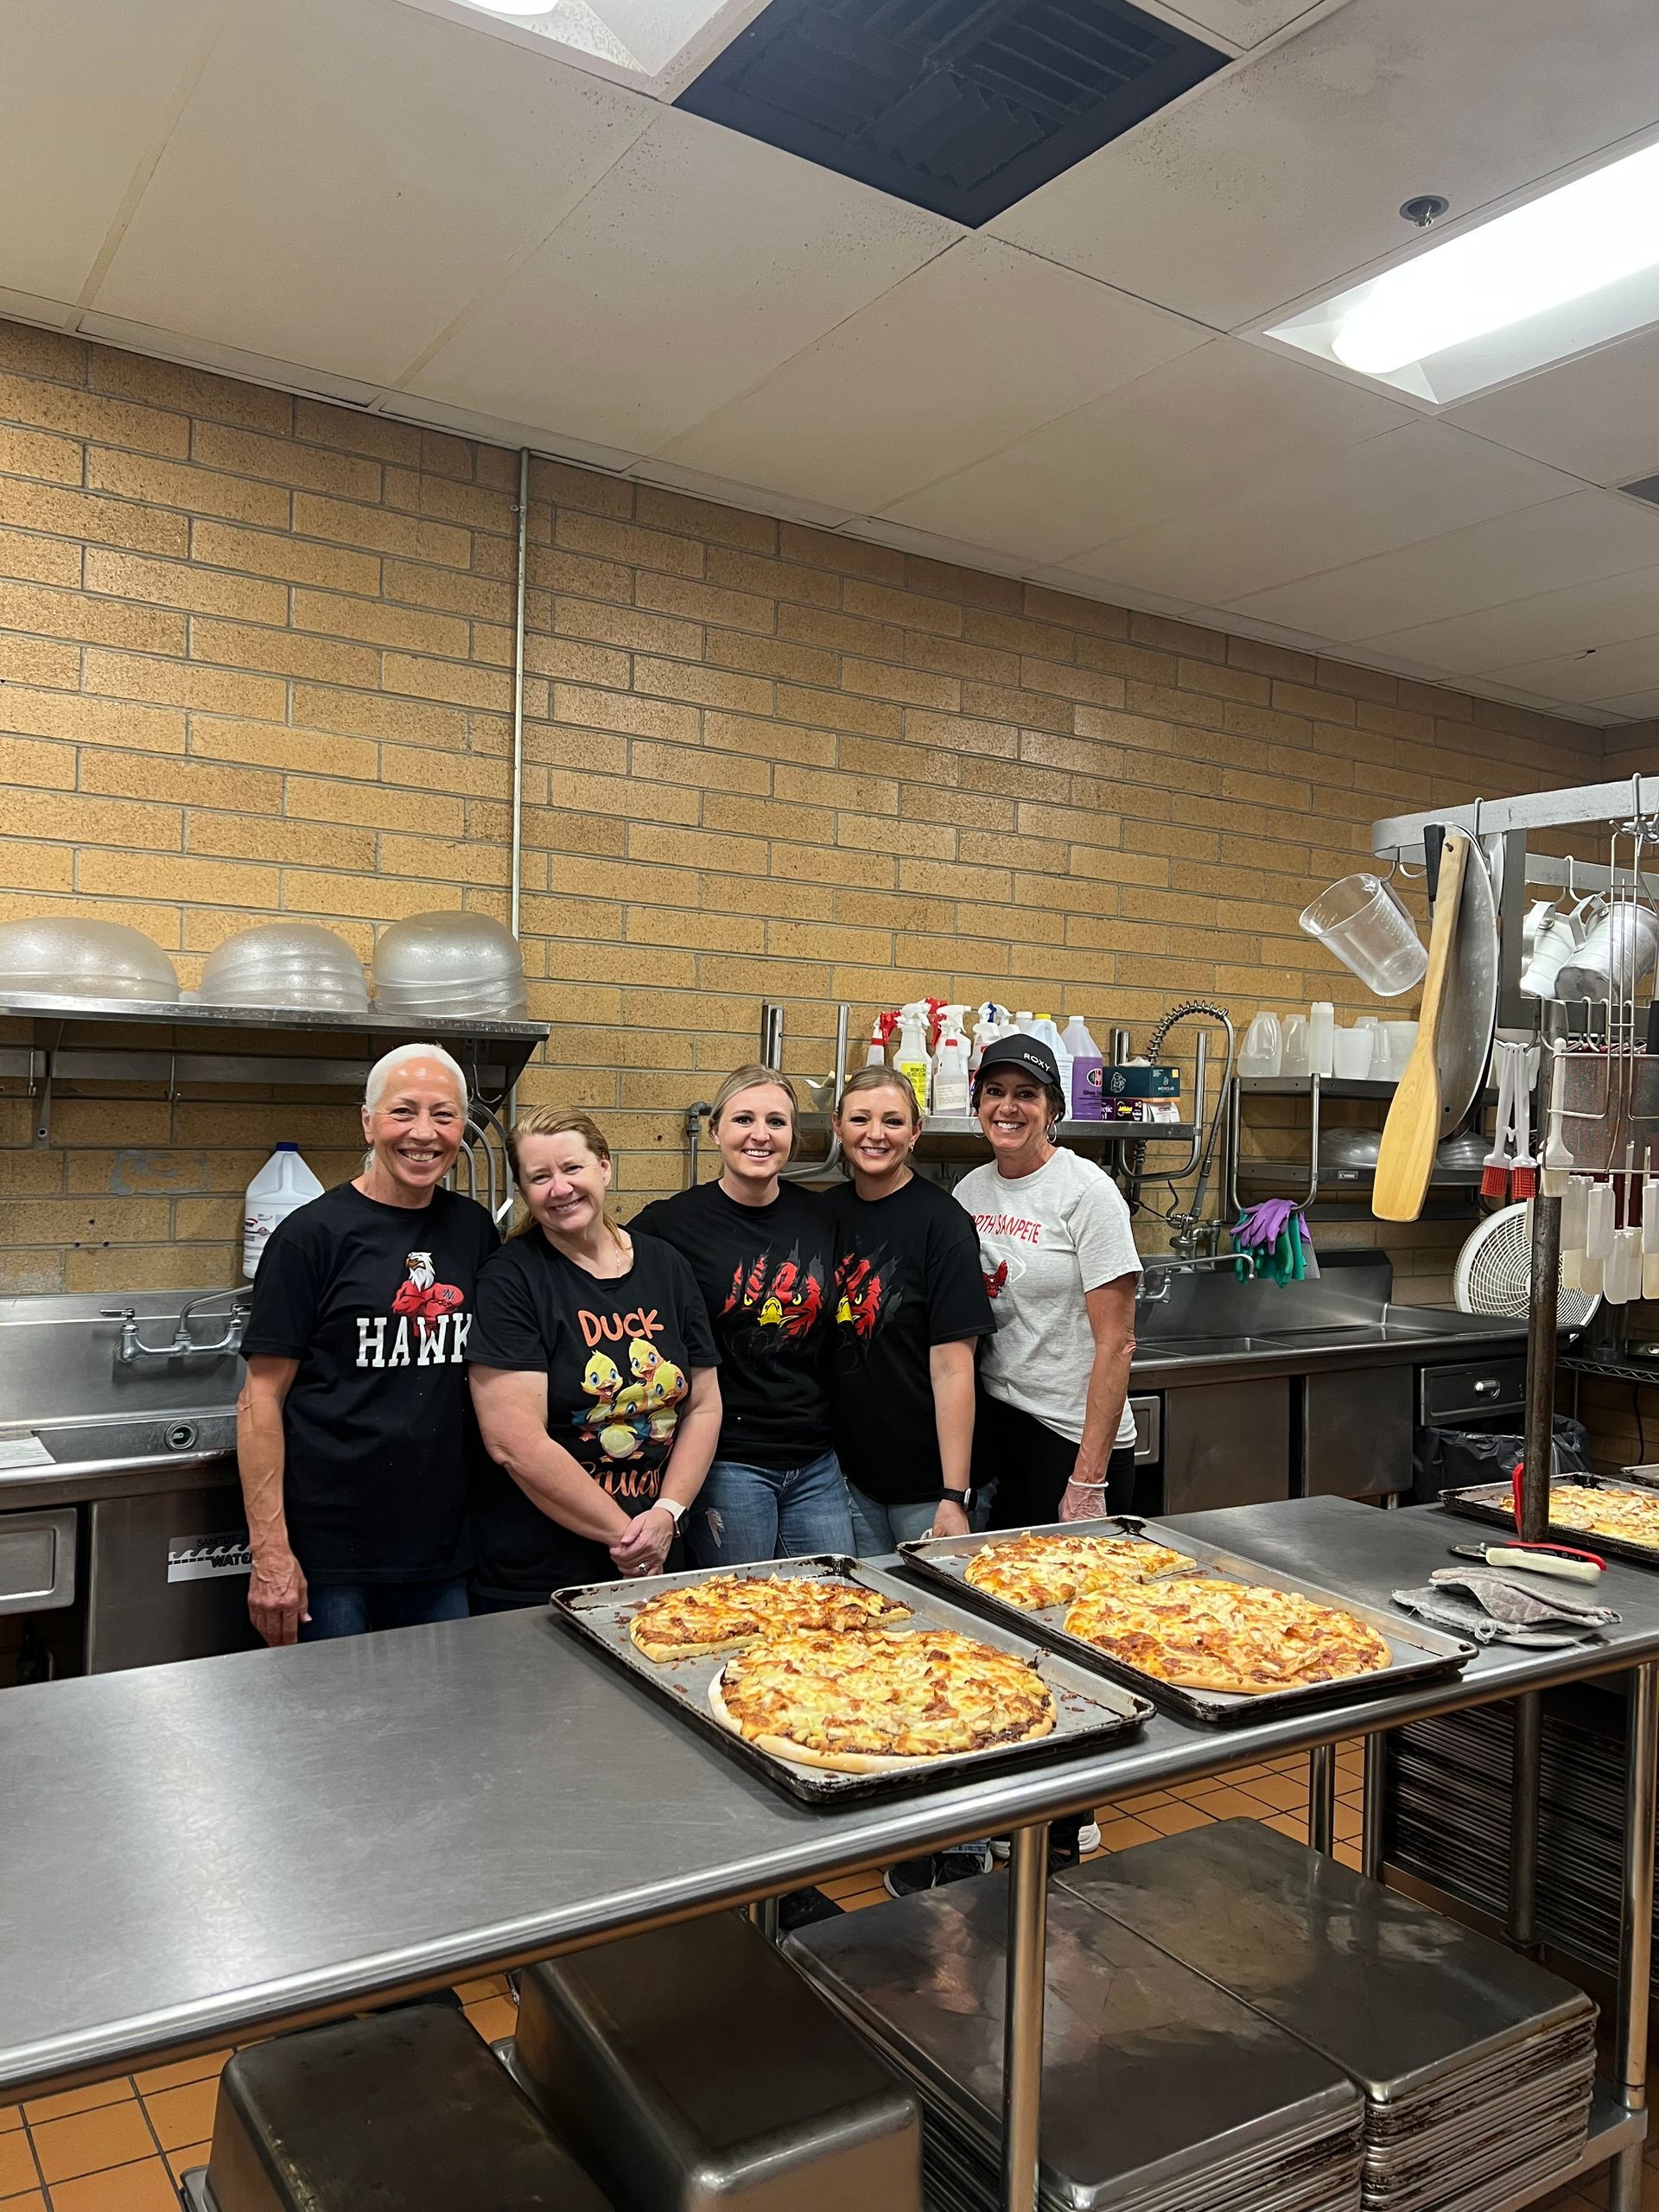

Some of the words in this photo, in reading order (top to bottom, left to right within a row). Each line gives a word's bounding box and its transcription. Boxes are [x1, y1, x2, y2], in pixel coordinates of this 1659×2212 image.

[1023, 1052, 1051, 1071] ROXY
[995, 1214, 1042, 1244] SANPETE
[577, 1307, 664, 1347] DUCK
[210, 1552, 252, 1568] WATE
